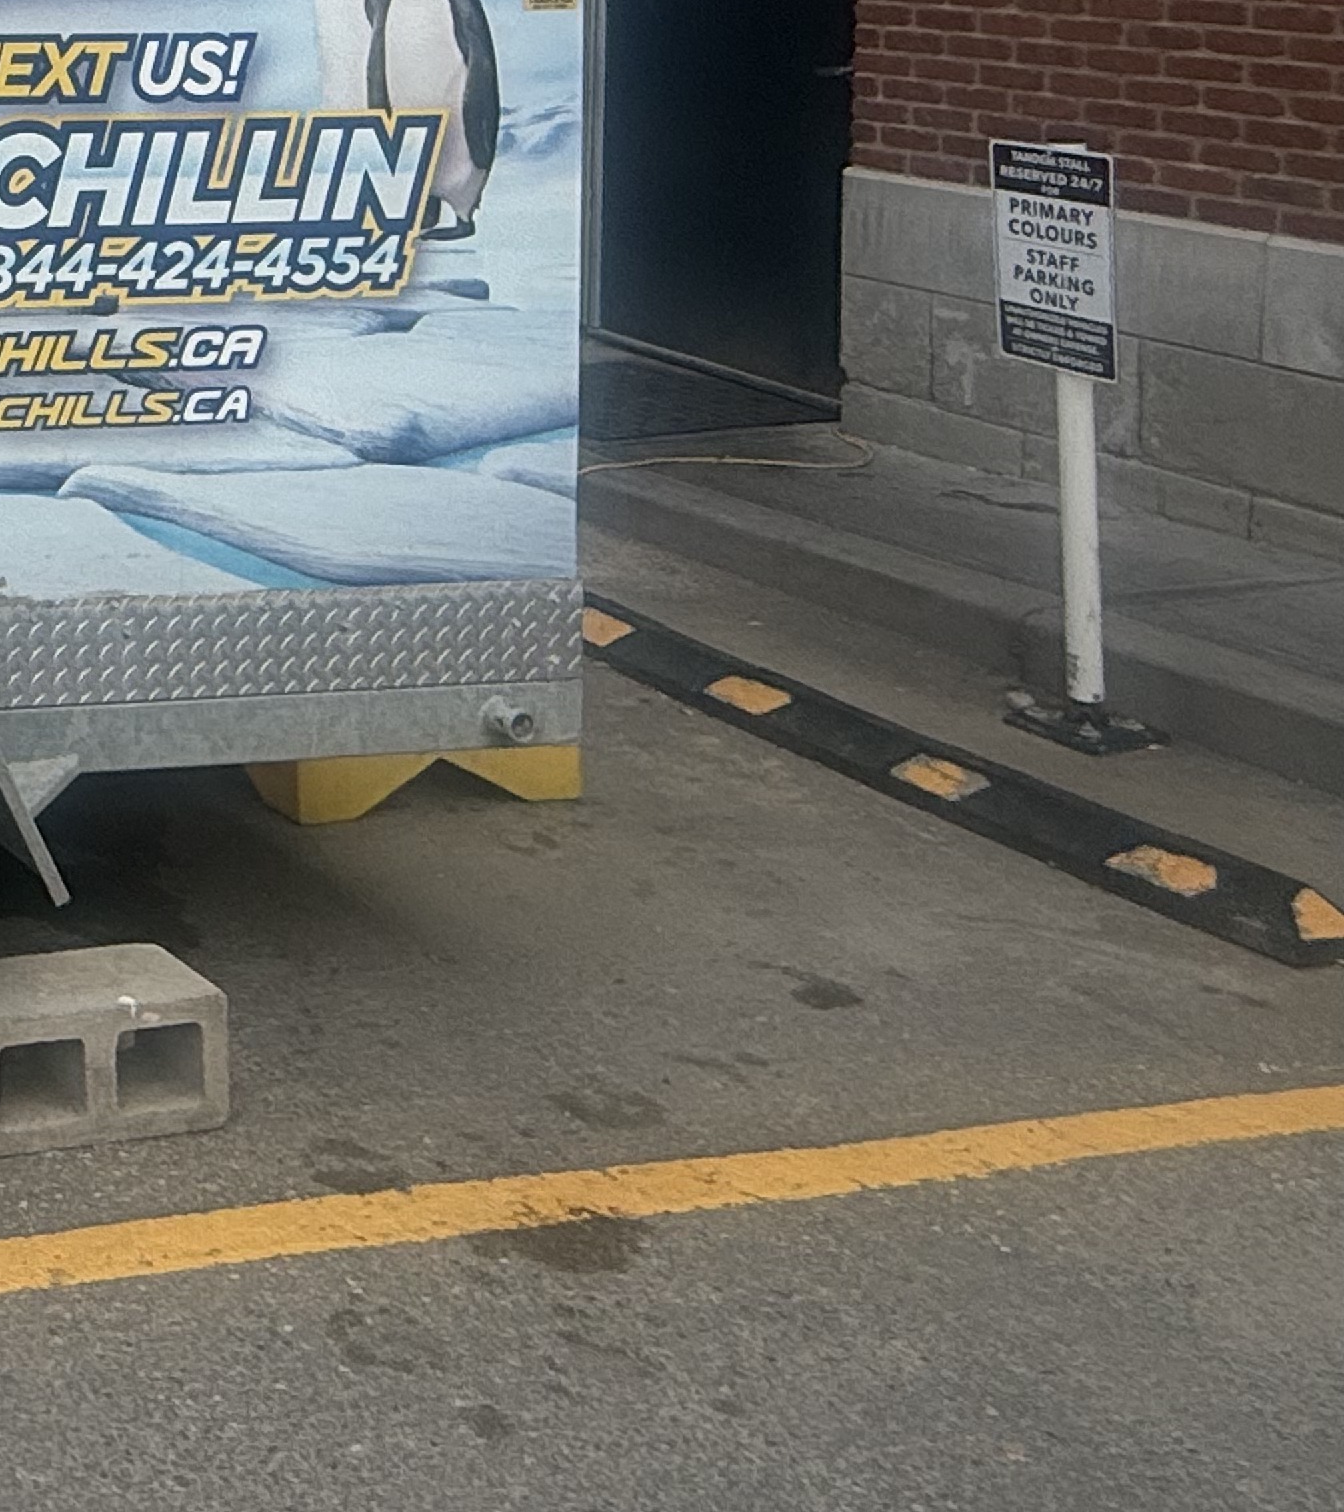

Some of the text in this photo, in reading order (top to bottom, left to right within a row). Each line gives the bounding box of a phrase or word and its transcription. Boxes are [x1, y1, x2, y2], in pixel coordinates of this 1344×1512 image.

[136, 34, 252, 90] US!
[999, 164, 1103, 193] RESERVED 24/7
[1009, 197, 1095, 226] PRIMARY
[1008, 218, 1097, 249] COLOURS
[1026, 249, 1081, 272] STAFF
[1013, 265, 1095, 296] PARKING
[1028, 288, 1080, 312] ONLY
